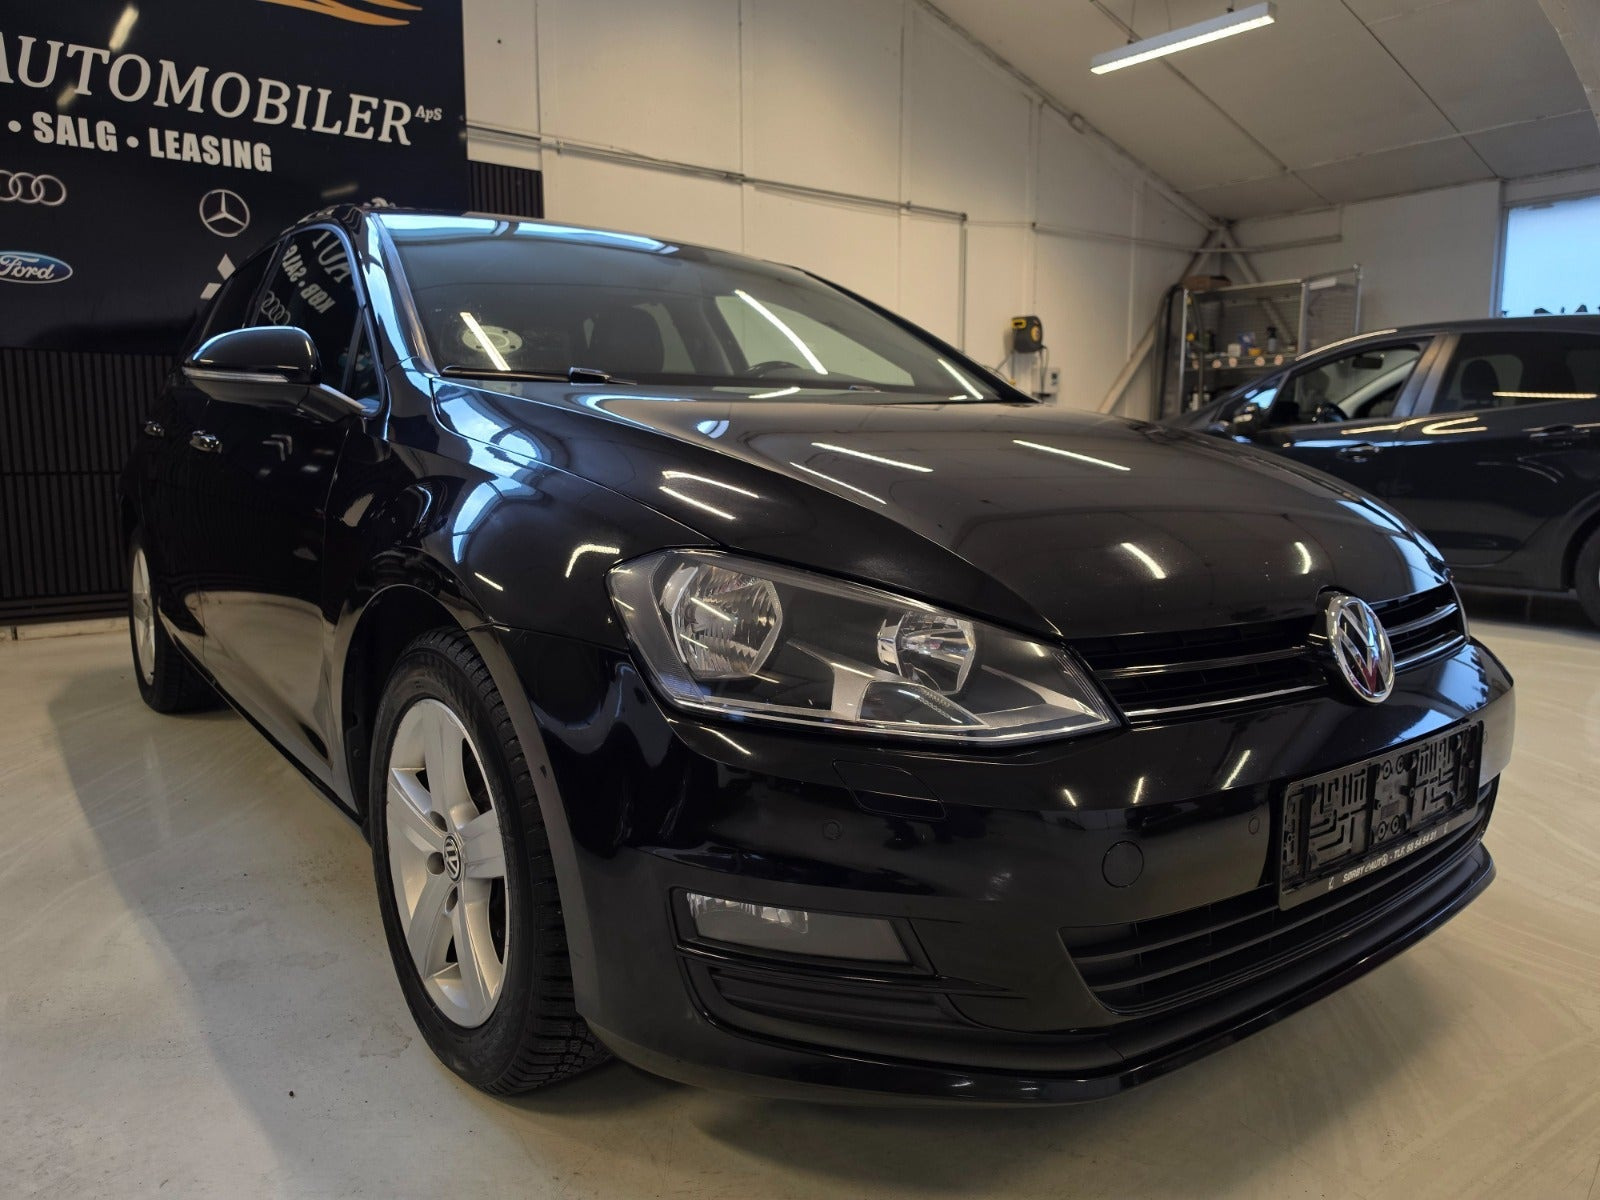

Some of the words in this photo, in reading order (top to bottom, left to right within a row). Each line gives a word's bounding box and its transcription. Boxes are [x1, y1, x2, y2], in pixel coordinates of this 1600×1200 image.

[415, 105, 442, 123] ApS
[32, 111, 118, 152] SALG
[149, 127, 273, 173] LEASING
[0, 255, 56, 280] Ford
